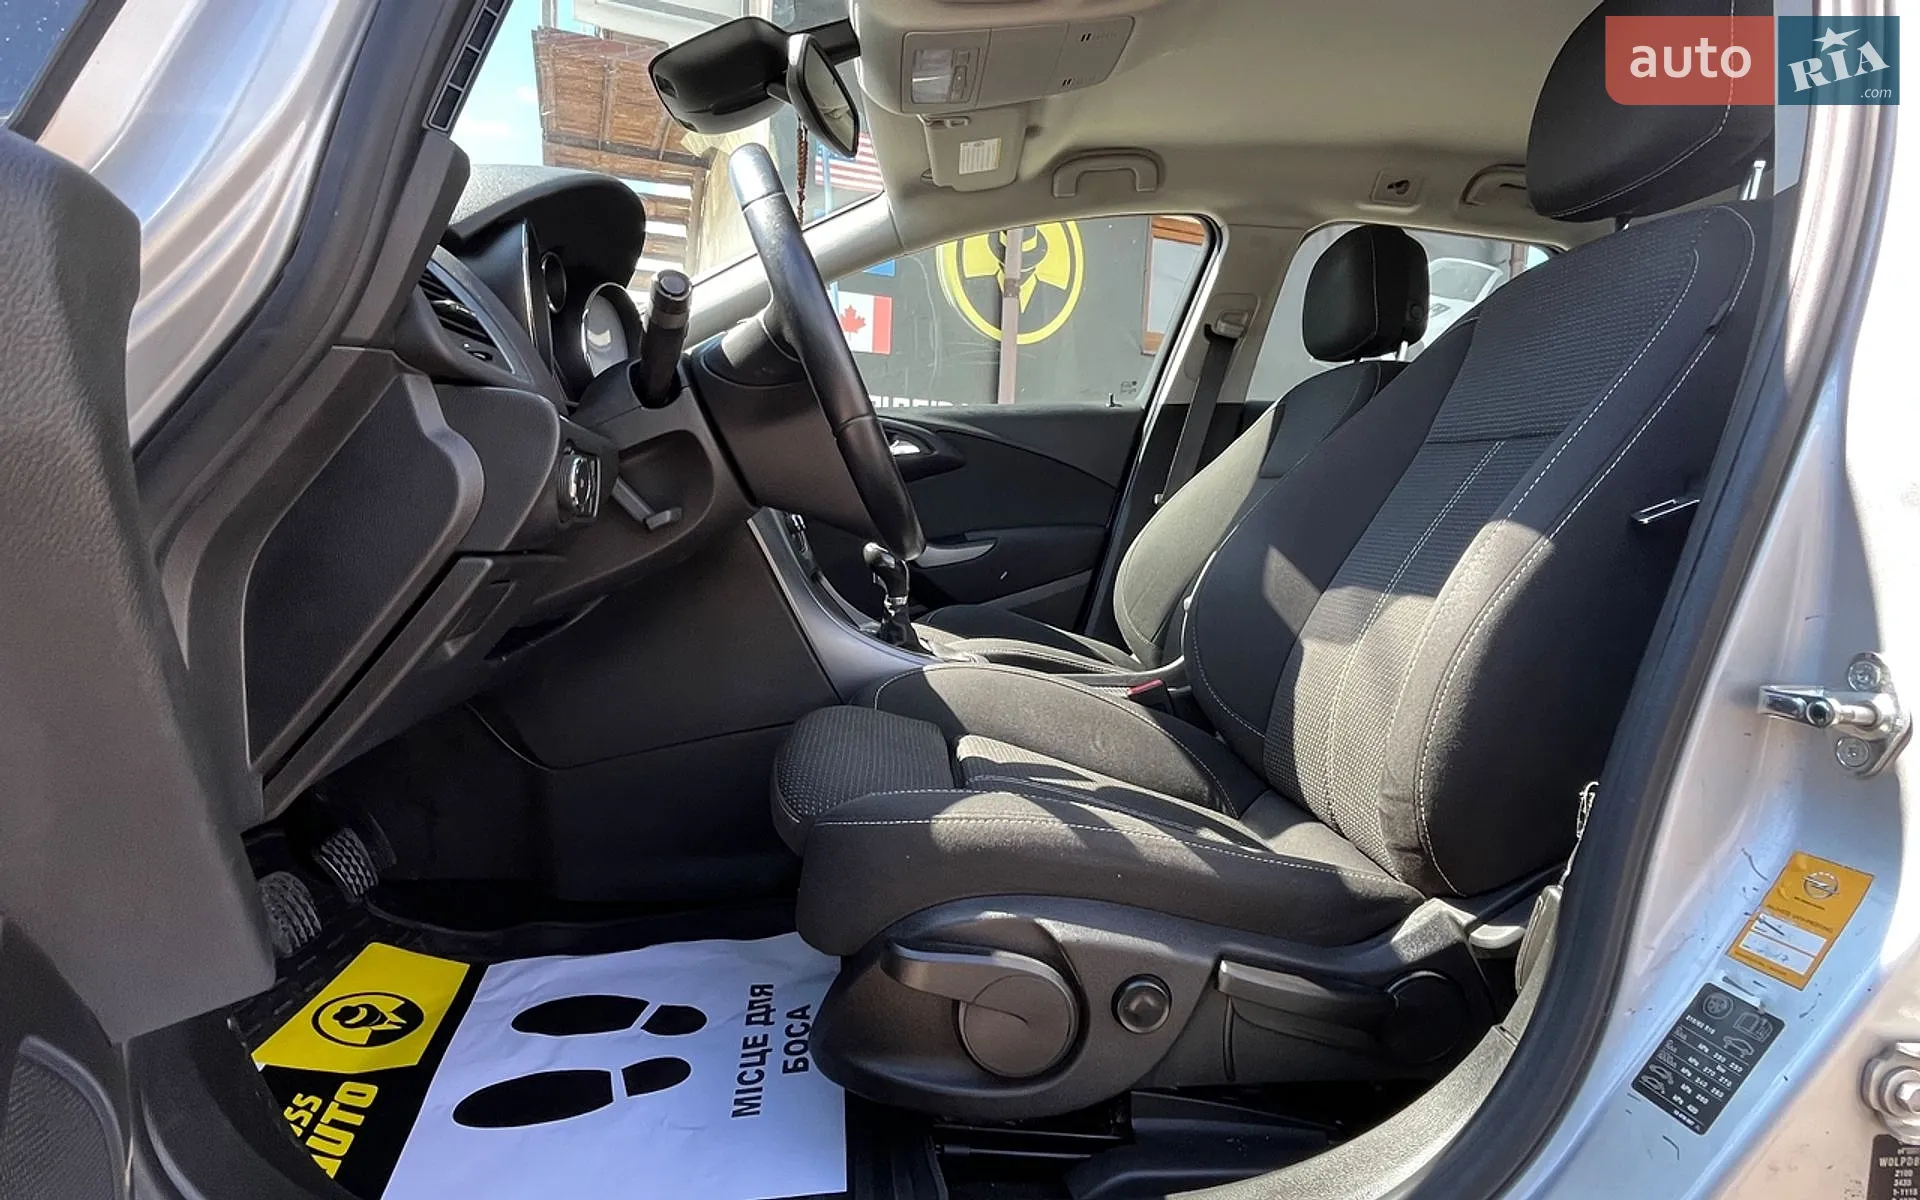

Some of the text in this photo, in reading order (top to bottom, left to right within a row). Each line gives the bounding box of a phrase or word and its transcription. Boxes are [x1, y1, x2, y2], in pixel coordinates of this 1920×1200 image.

[731, 984, 776, 1118] МІСЦЕ ДЛЯ
[782, 1004, 811, 1074] БОСА
